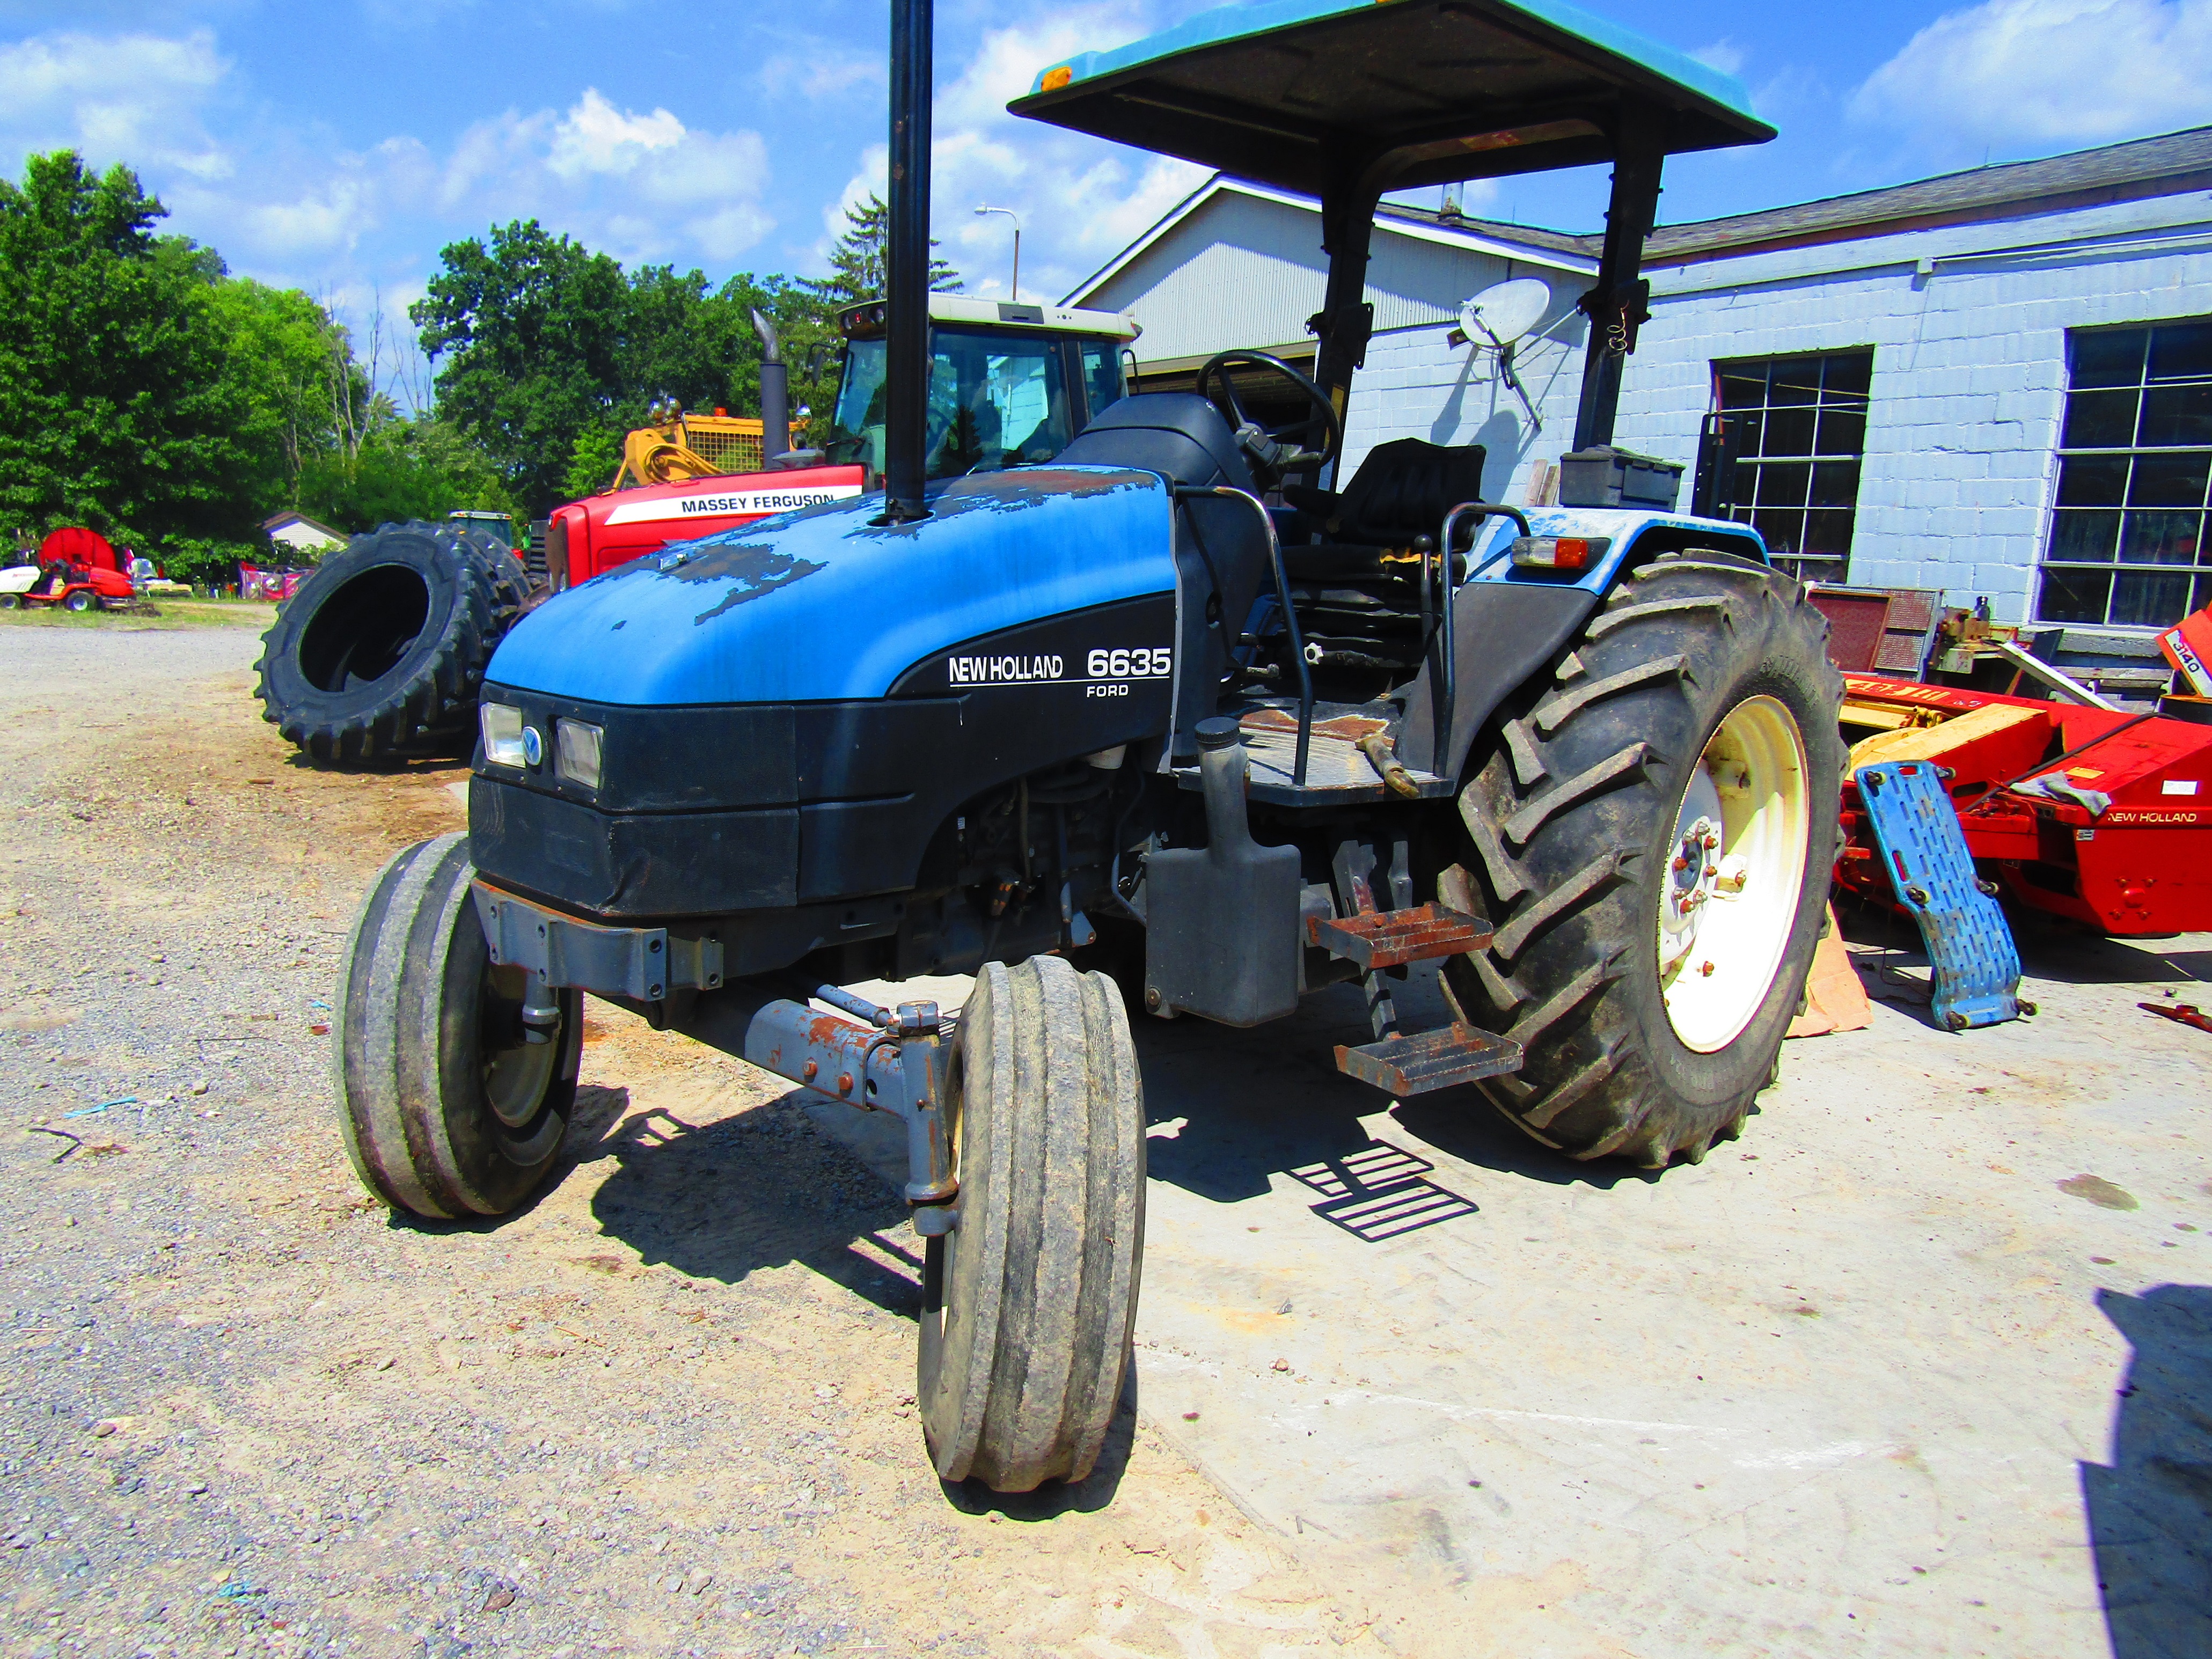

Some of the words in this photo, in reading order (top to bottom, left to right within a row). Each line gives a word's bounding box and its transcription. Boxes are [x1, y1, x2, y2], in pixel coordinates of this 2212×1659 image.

[682, 497, 747, 513] MASSEY
[754, 494, 834, 508] FERGUSON
[949, 656, 988, 682] NEW
[990, 655, 1063, 680] HOLLAND
[1087, 648, 1171, 677] 6635
[1086, 685, 1129, 698] FORD
[2108, 813, 2137, 822] NEW
[2140, 812, 2197, 823] HOLLAND
